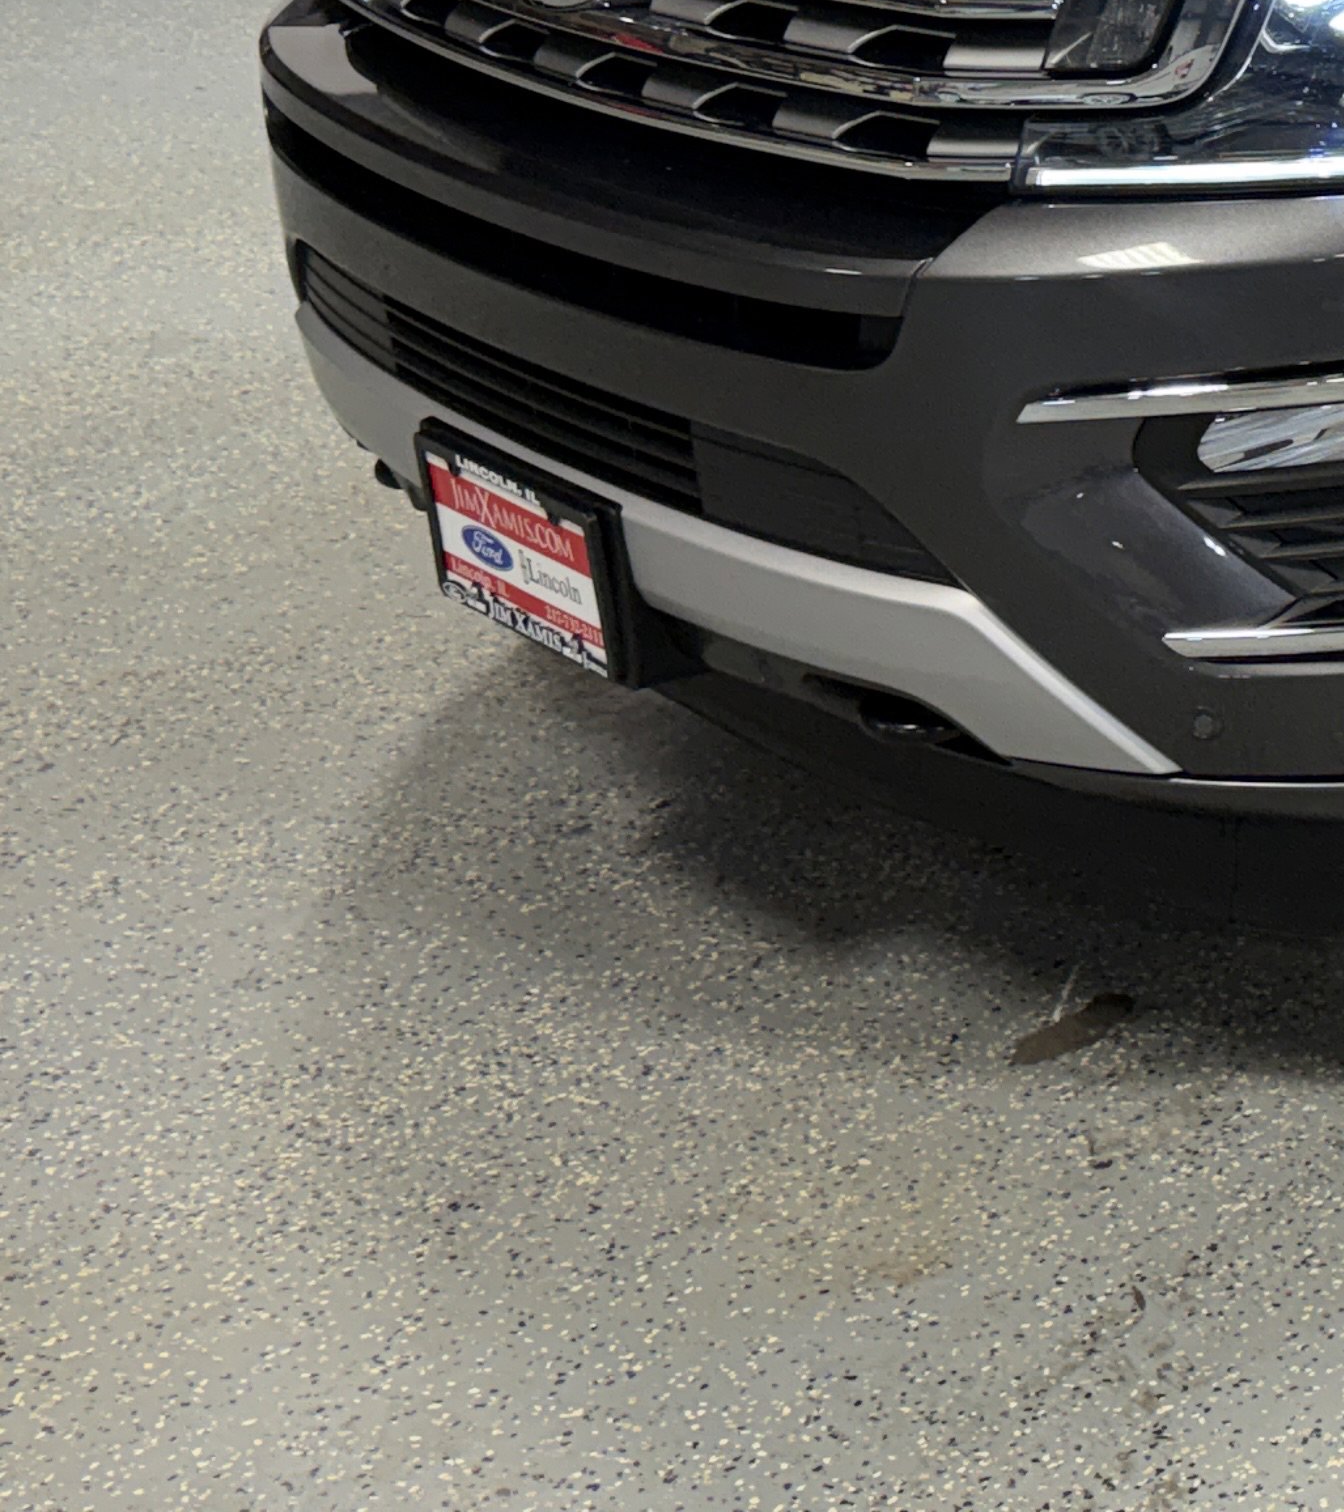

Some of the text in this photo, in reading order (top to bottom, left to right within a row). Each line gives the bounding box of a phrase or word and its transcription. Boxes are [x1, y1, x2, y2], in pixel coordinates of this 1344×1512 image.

[454, 454, 540, 506] LINCOLN, IL
[471, 530, 504, 565] Ford
[527, 558, 582, 605] Lincoln
